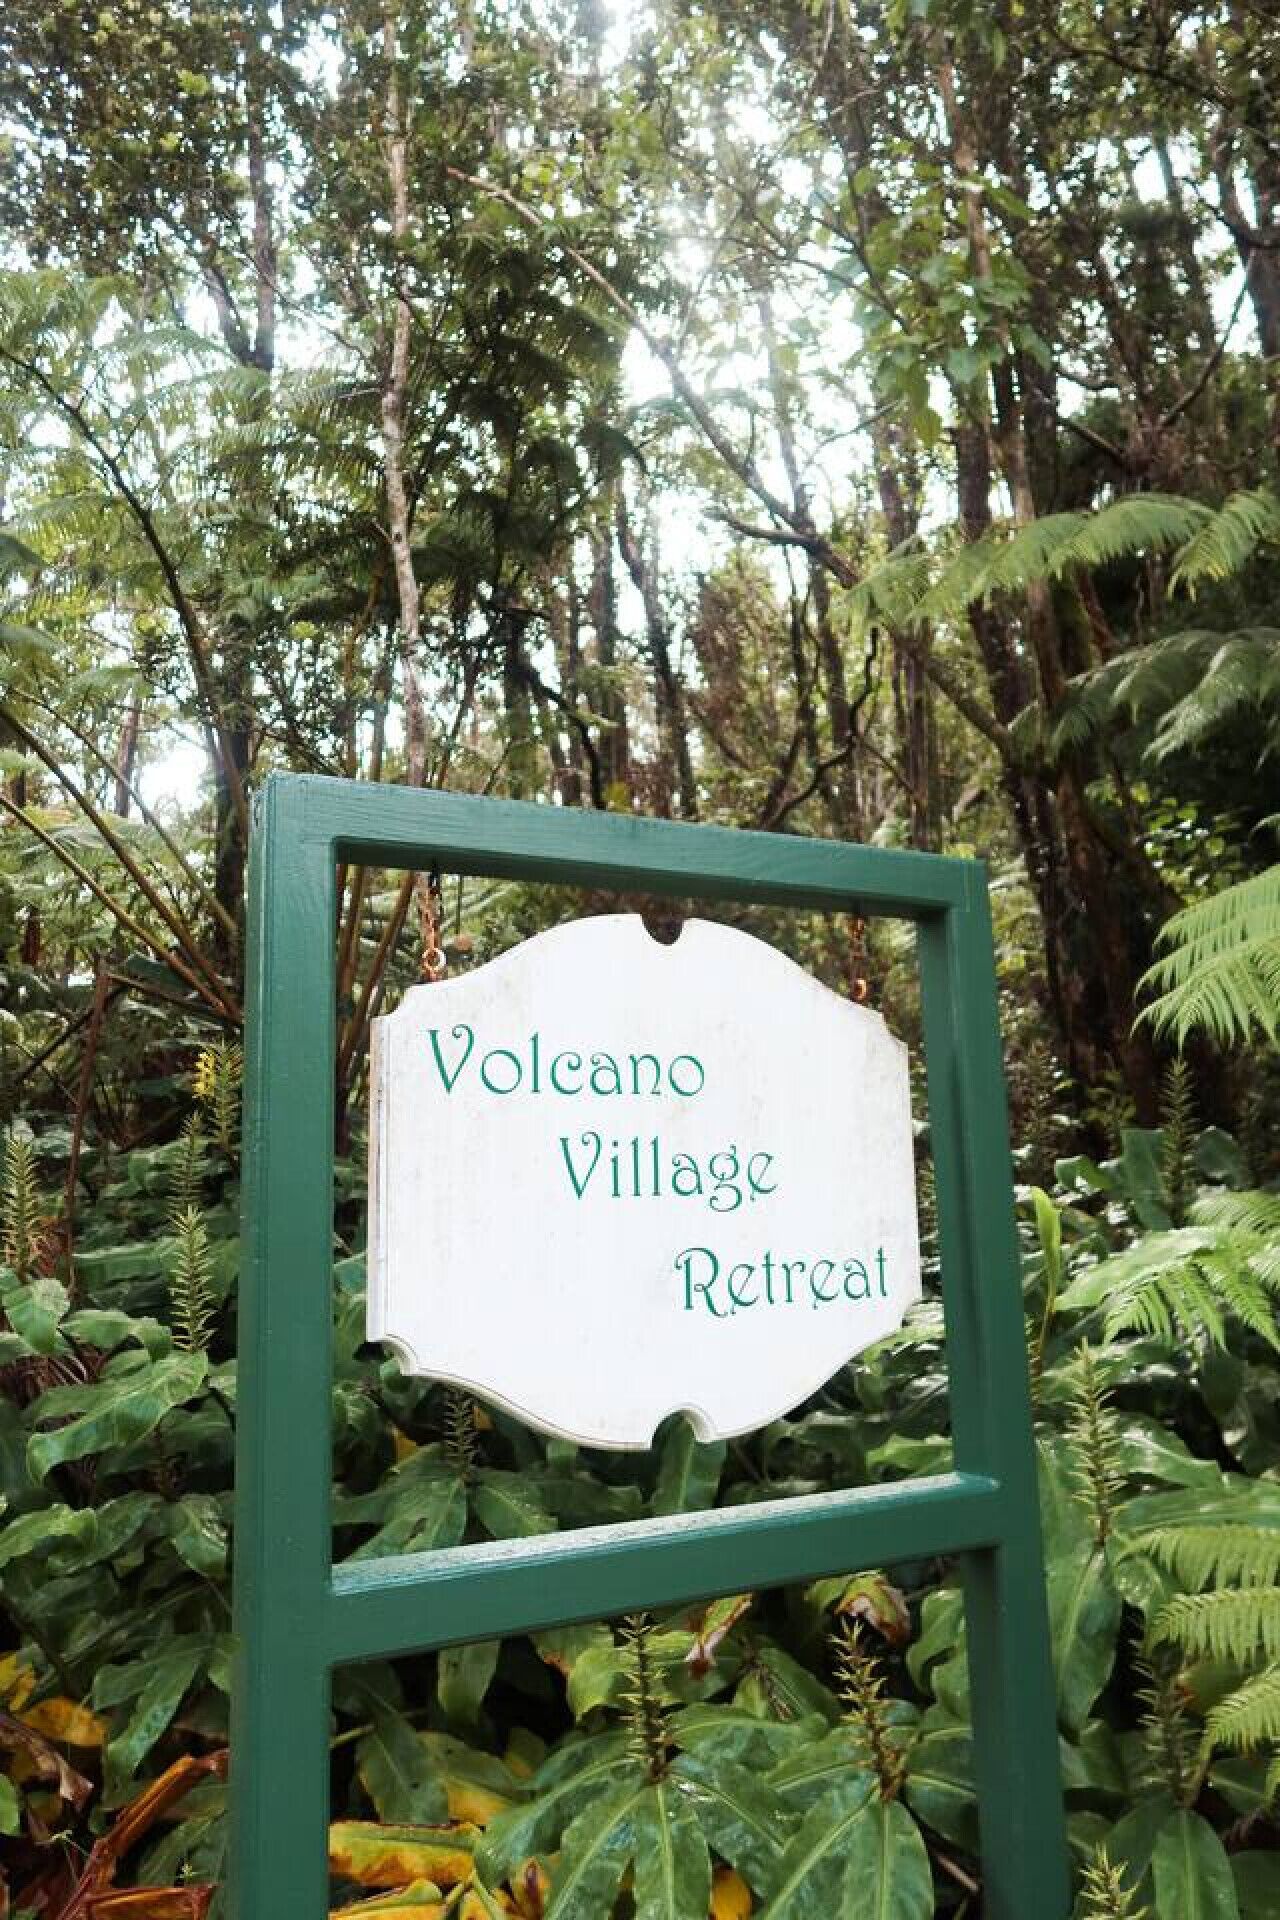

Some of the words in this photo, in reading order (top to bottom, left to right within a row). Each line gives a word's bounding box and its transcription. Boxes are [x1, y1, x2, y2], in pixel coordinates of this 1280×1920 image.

[427, 1024, 705, 1097] Volcano
[559, 1131, 778, 1213] Village
[674, 1246, 888, 1318] Retreat
